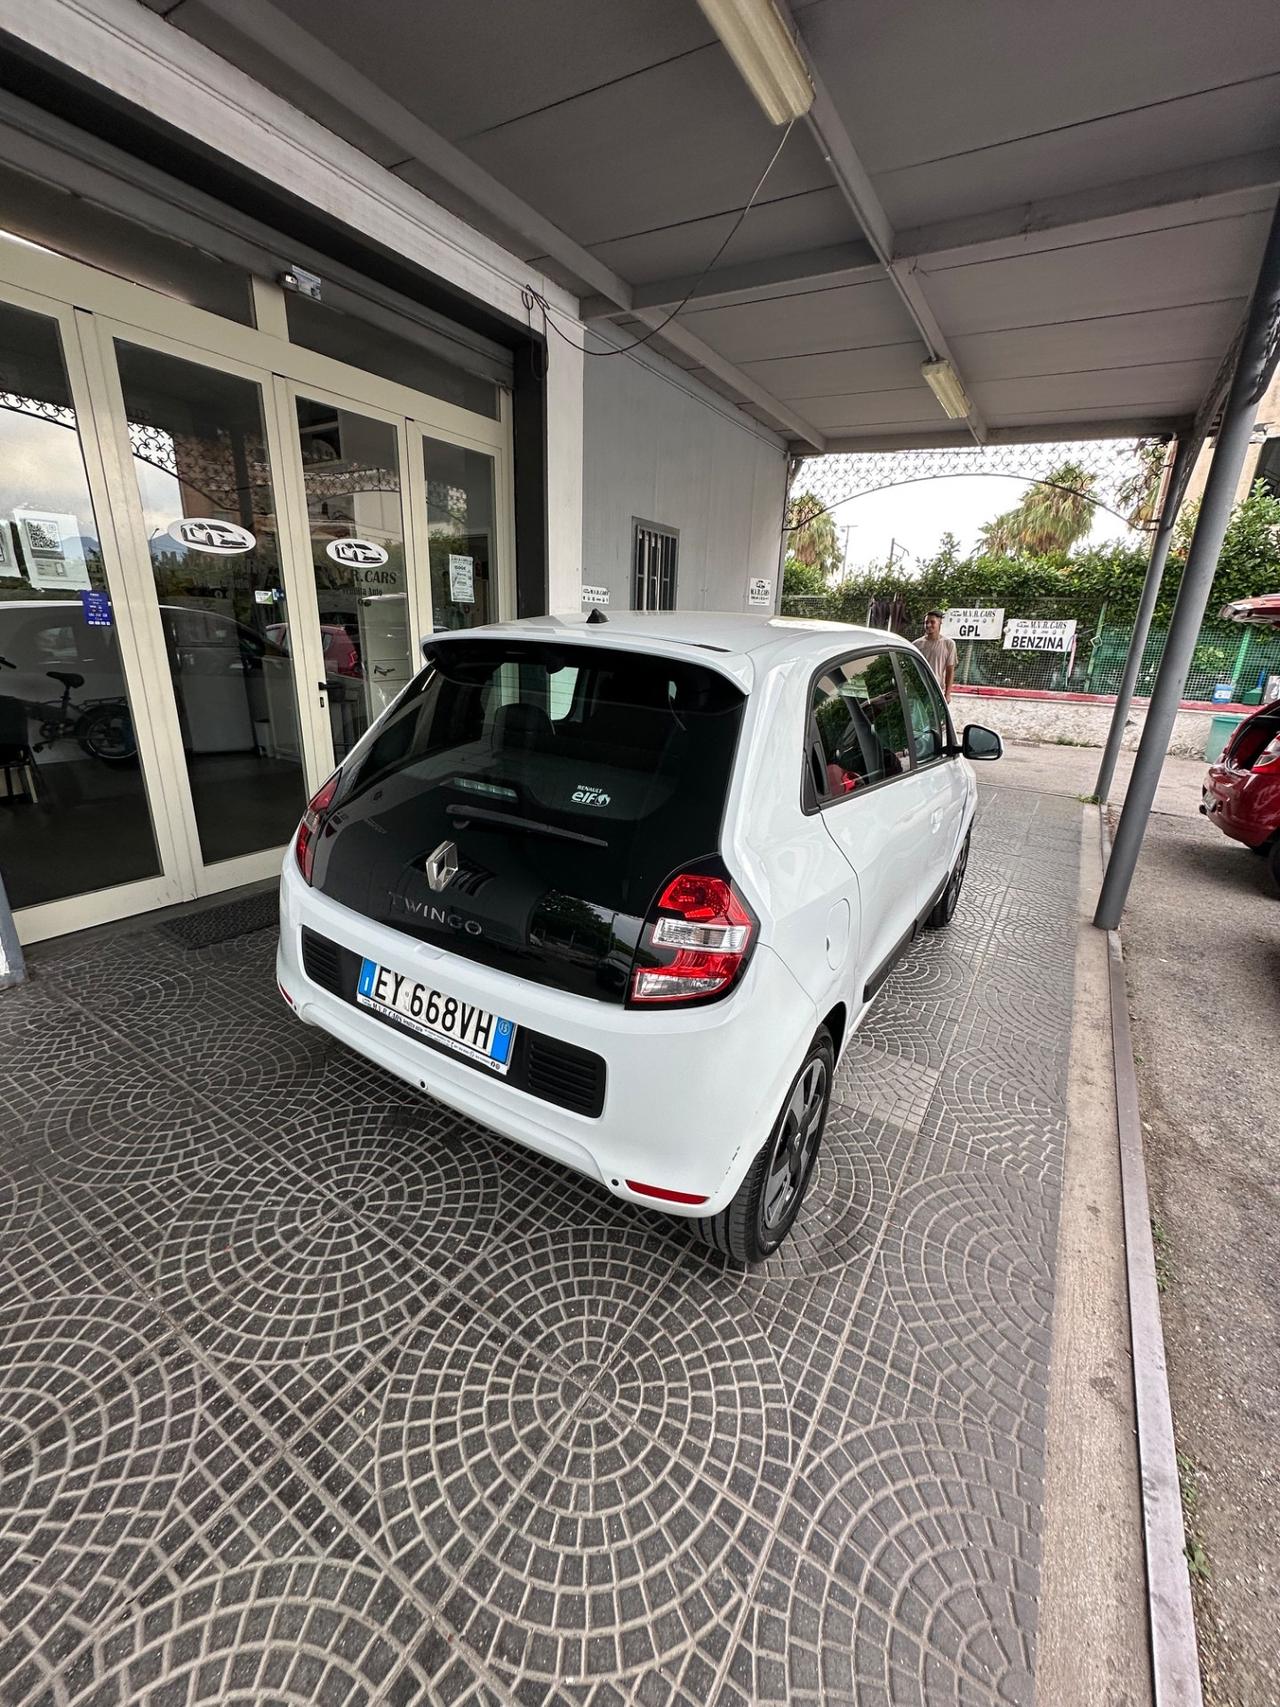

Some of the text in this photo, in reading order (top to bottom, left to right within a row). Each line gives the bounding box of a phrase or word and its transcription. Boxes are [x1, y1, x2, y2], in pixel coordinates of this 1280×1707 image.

[959, 624, 981, 637] GPL
[1011, 635, 1063, 650] BENZINA
[577, 784, 603, 794] RENAULT
[571, 791, 598, 804] elf
[387, 890, 483, 936] TWINGO
[374, 964, 494, 1050] EY 668VH
